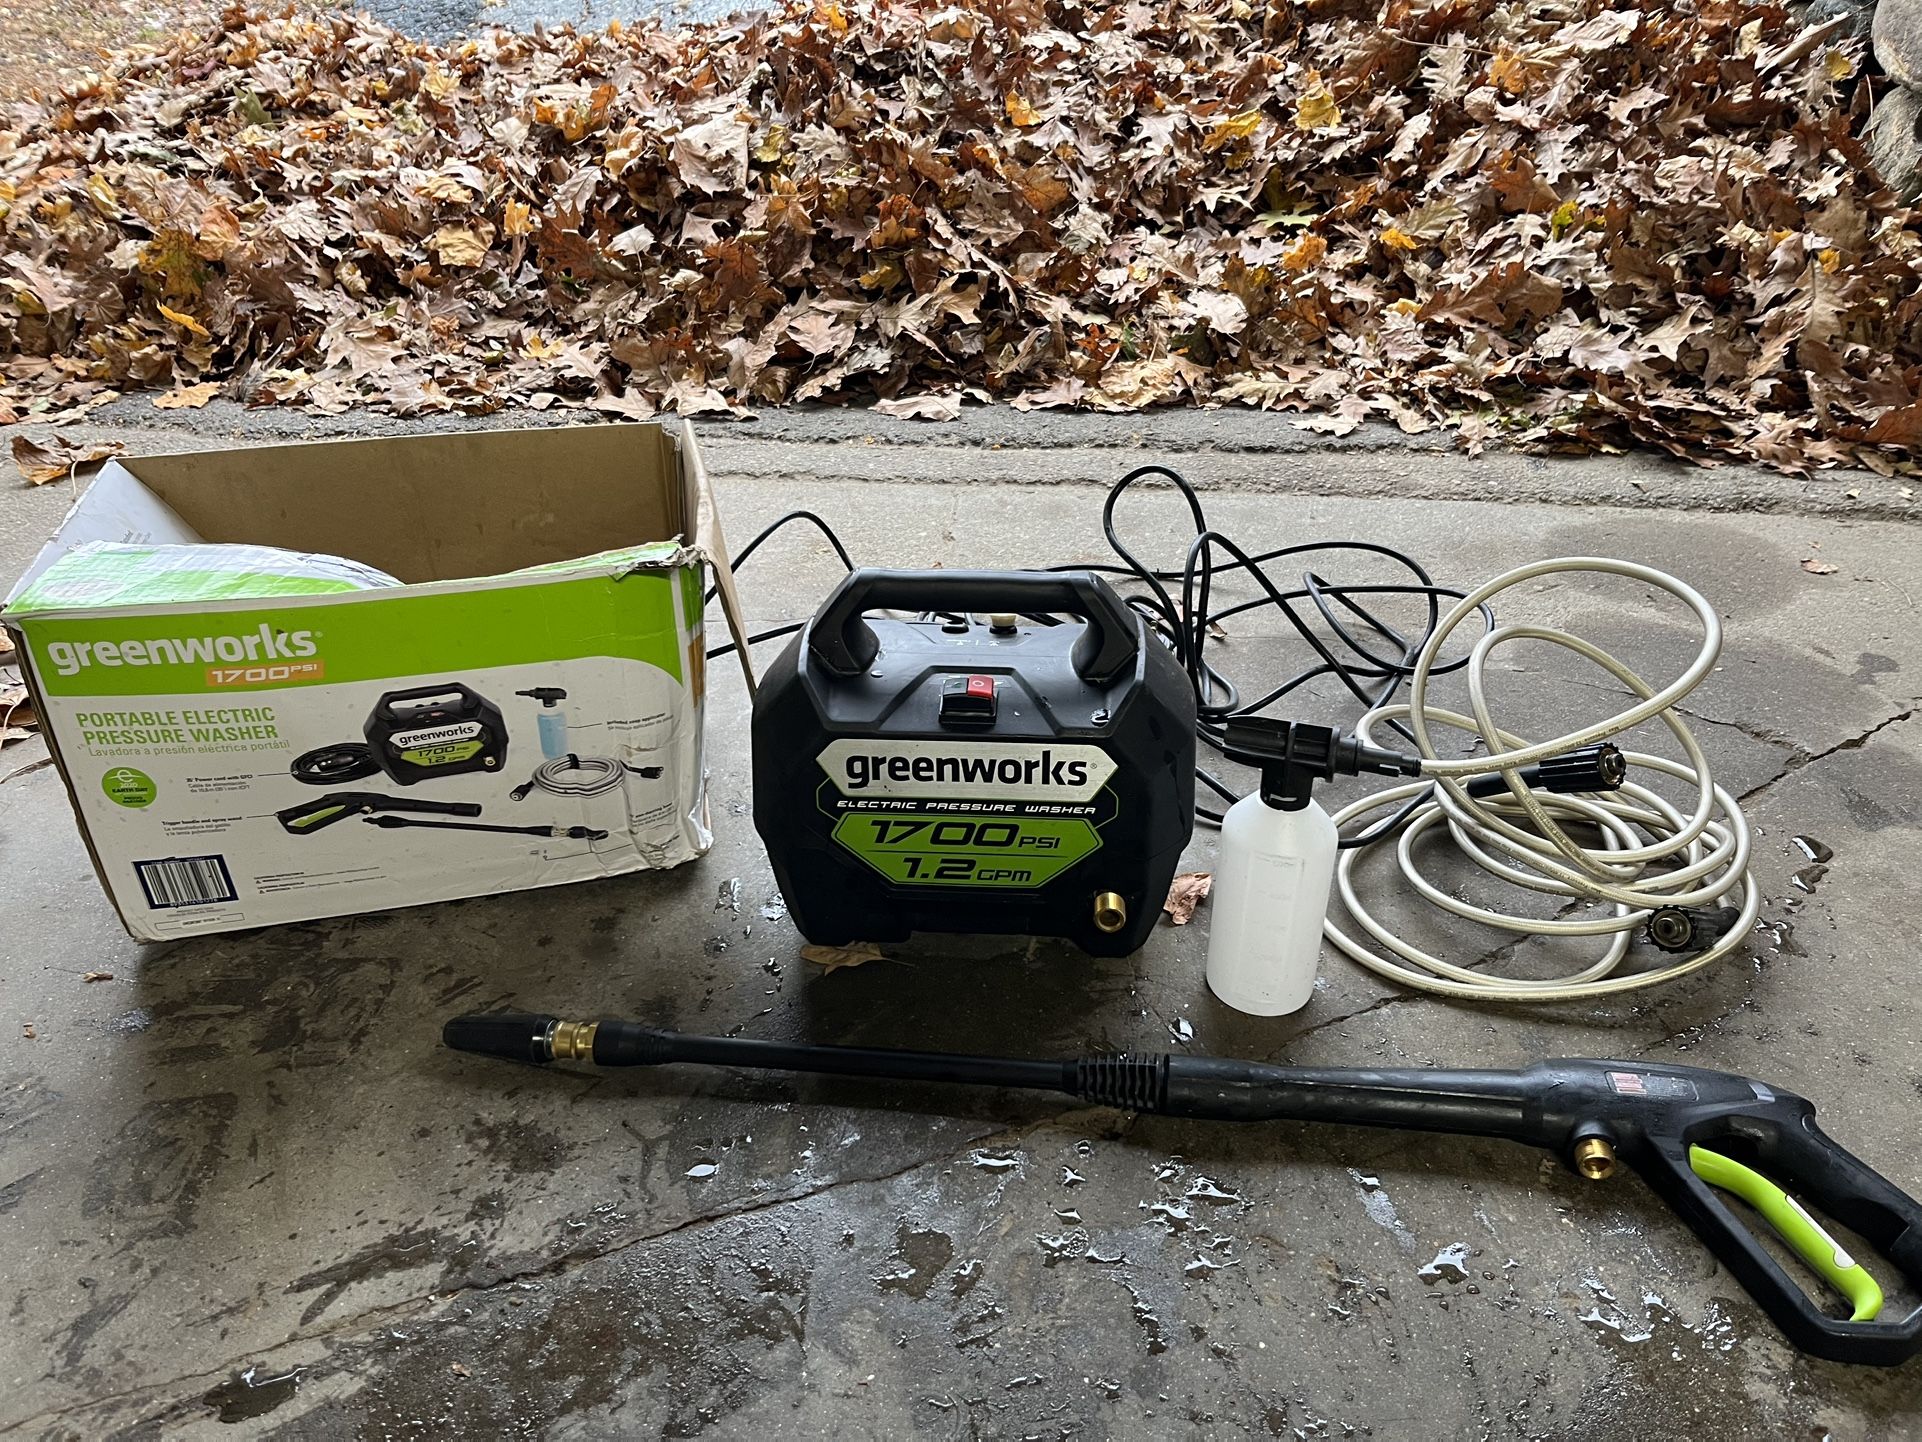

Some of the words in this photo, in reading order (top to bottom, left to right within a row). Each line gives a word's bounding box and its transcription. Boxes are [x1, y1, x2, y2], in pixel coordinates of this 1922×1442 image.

[48, 623, 317, 676] greenworks
[75, 711, 179, 728] PORTABLE
[182, 707, 275, 725] ELECTRIC
[83, 728, 187, 746] PRESSURE
[189, 725, 278, 743] WASHER
[399, 725, 474, 746] greenworks
[89, 745, 141, 757] Lavadora
[154, 744, 195, 756] presión
[198, 742, 248, 754] eléctrica
[251, 740, 290, 752] portátil
[418, 745, 456, 757] 1700
[846, 750, 1088, 789] greenworks
[837, 800, 918, 810] ELECTRIC
[926, 802, 1017, 812] PRESSURE
[1025, 805, 1097, 815] WASHER
[870, 820, 1020, 848] 1700
[1018, 836, 1061, 849] PSI
[903, 857, 977, 880] 1.2
[976, 870, 1032, 882] GPM
